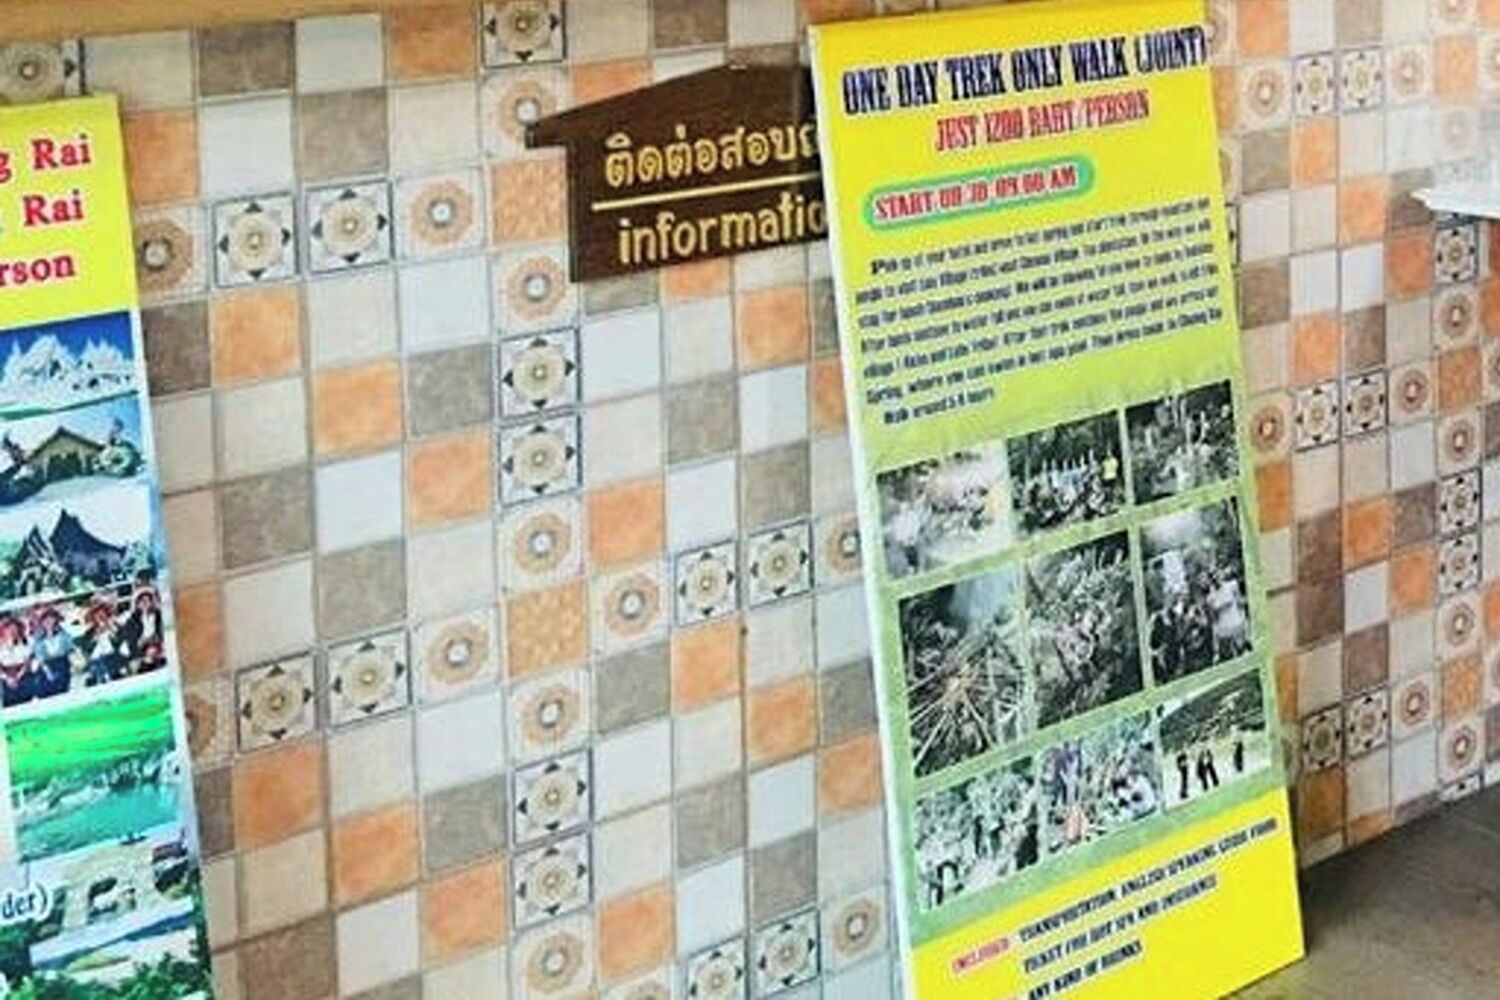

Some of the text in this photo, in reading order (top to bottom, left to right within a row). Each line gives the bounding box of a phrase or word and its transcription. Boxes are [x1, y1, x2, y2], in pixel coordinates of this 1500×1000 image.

[843, 66, 892, 116] ONE
[895, 60, 939, 108] DAY
[945, 52, 1007, 101] TREK
[1011, 45, 1063, 93] ONLY
[1069, 36, 1129, 83] WALK
[31, 133, 91, 171] Rai
[936, 114, 978, 152] JUST
[22, 188, 84, 227] Rai
[876, 190, 933, 219] START
[1050, 165, 1077, 190] AM
